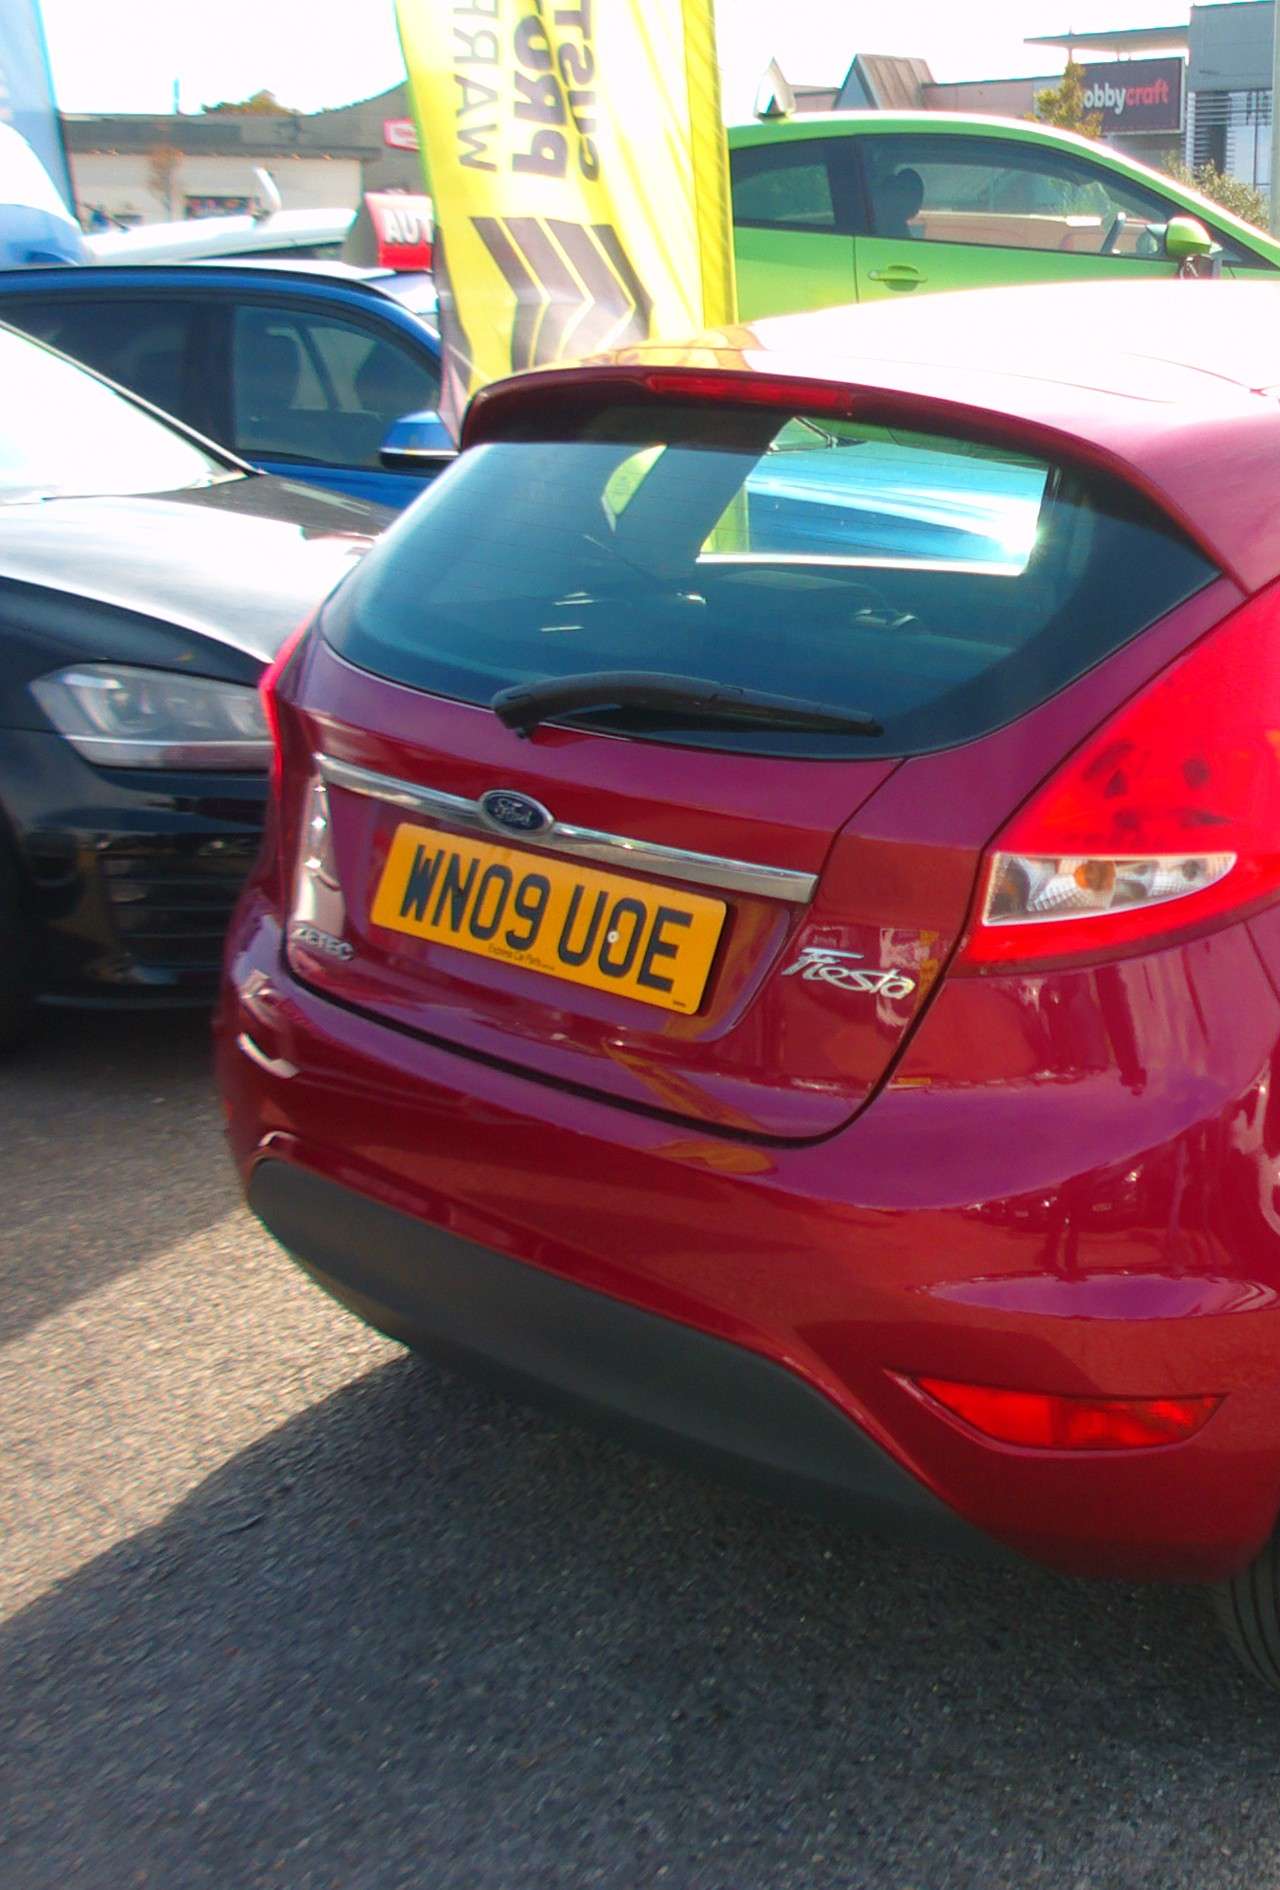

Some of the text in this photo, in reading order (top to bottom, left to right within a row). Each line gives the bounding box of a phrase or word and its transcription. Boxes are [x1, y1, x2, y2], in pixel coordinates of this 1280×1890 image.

[1079, 79, 1169, 115] obbycraft
[399, 844, 693, 992] WN09 UOE
[781, 947, 916, 999] Fiesta
